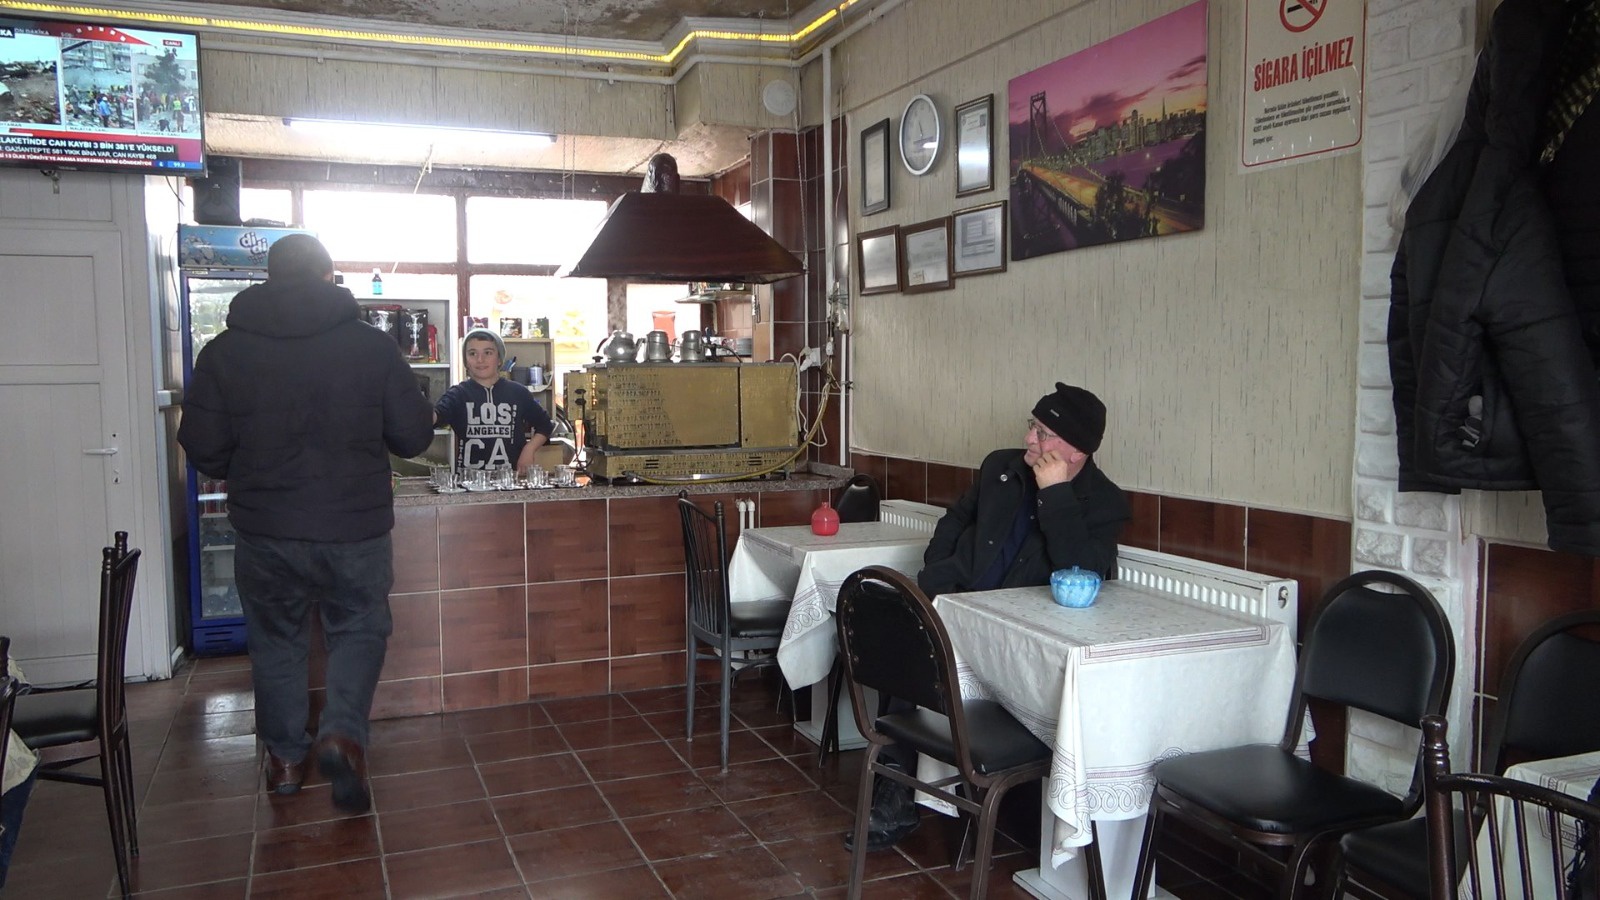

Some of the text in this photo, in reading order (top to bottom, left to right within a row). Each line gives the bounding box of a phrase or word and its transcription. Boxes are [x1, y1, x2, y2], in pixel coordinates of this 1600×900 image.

[1254, 36, 1354, 92] SİGARA İÇİLMEZ
[100, 141, 114, 150] BİN
[136, 143, 174, 153] YÜKSELDİ
[466, 402, 511, 424] LOS
[467, 426, 510, 436] ANGELES
[464, 438, 512, 470] CA
